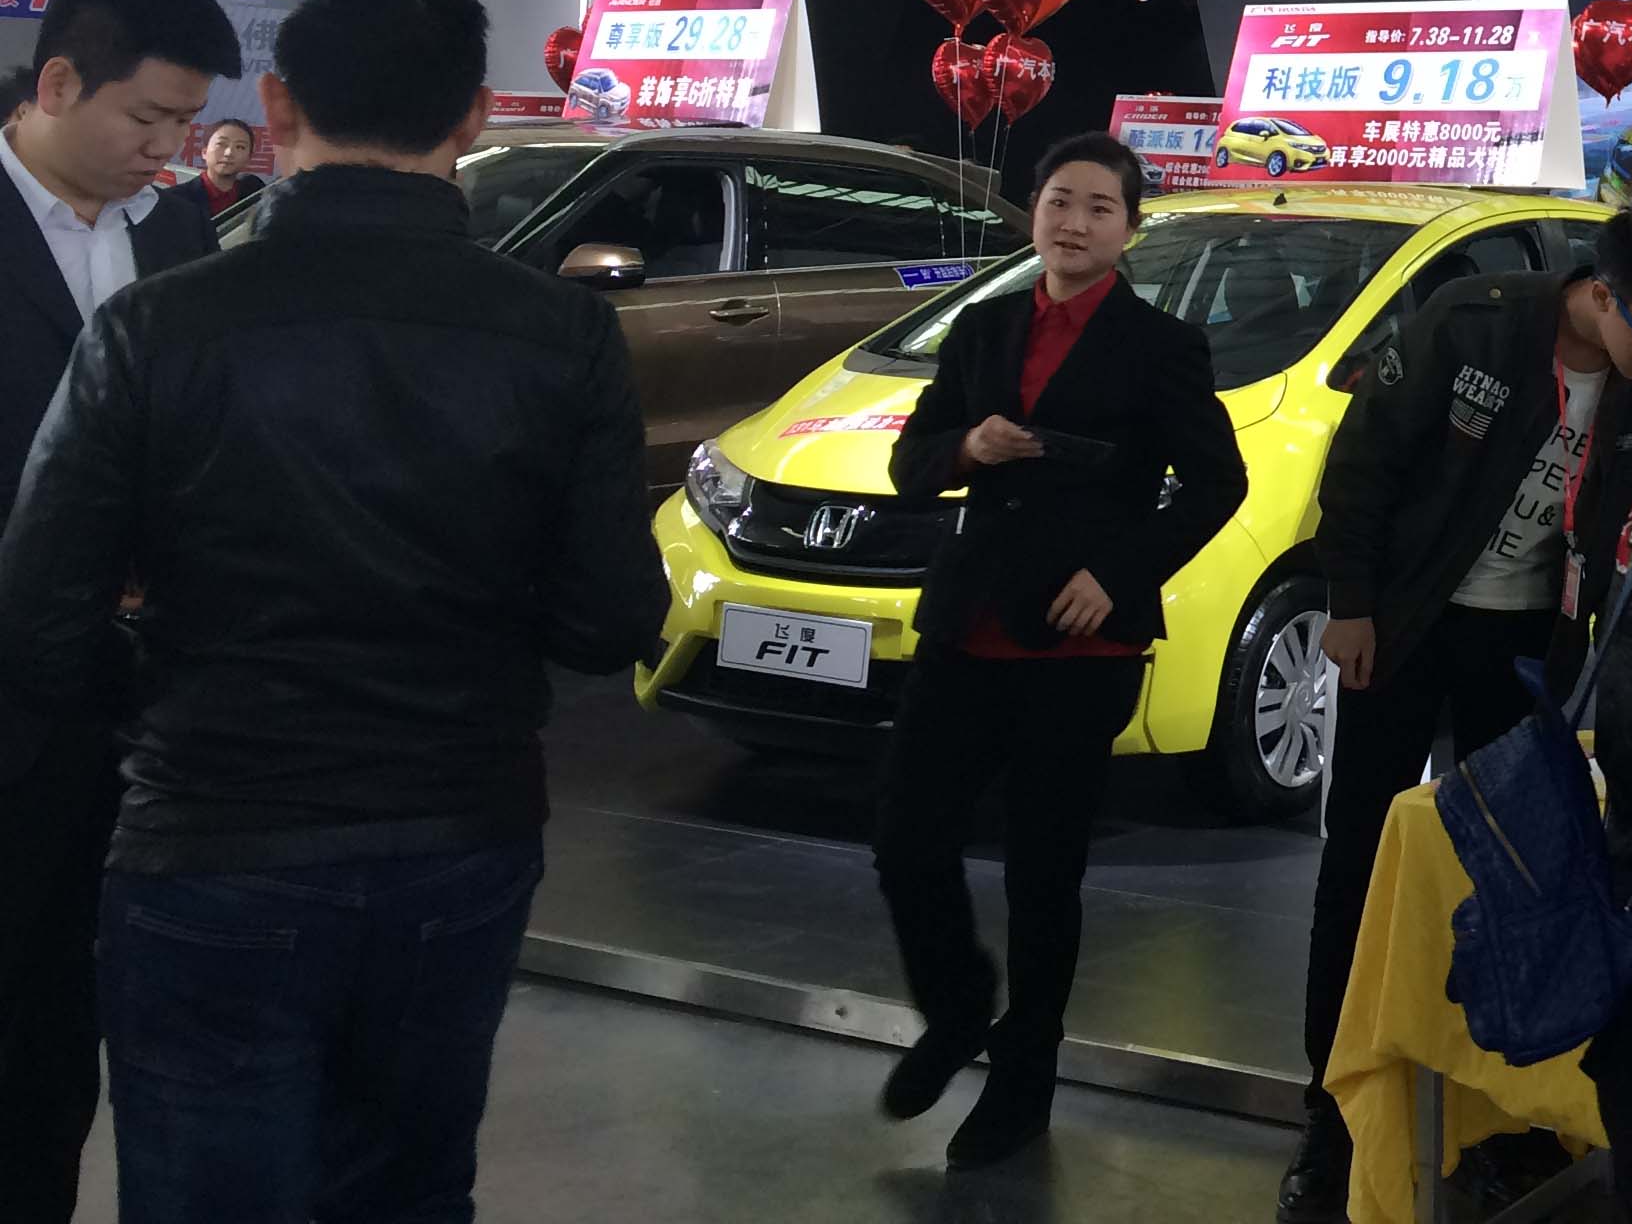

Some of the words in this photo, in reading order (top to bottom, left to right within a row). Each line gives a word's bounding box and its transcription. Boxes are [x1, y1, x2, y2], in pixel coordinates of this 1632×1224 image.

[1271, 34, 1330, 48] FIT
[1410, 26, 1514, 46] 7.38-11.28
[1262, 66, 1362, 101] 科技版
[1379, 57, 1501, 105] 9.18
[1363, 120, 1502, 144] 车展特惠8000元
[775, 623, 816, 644] 飞度
[756, 641, 830, 668] FIT
